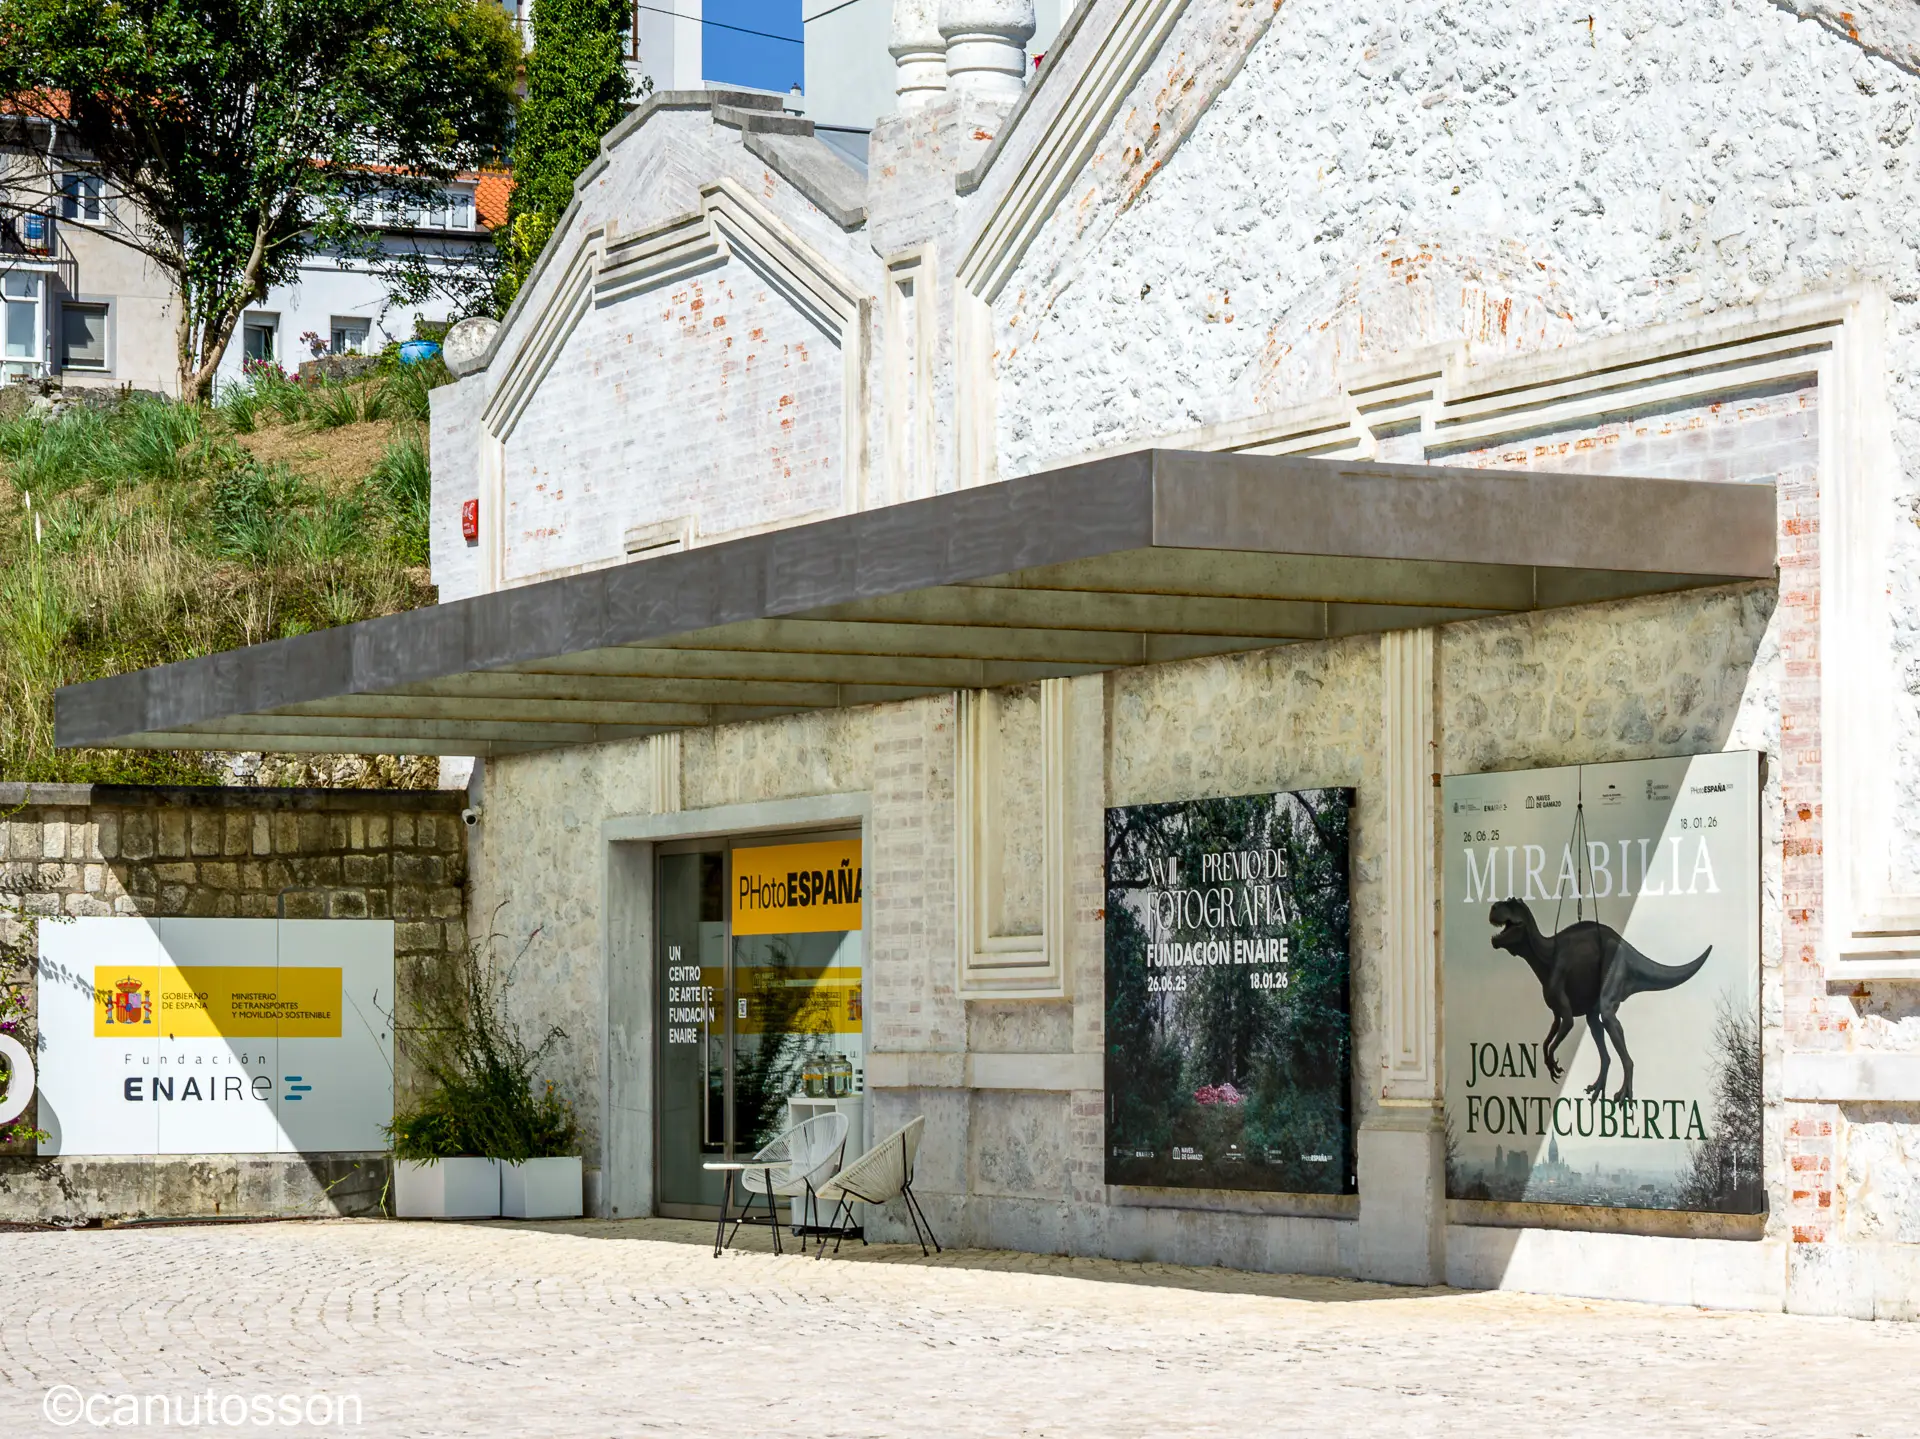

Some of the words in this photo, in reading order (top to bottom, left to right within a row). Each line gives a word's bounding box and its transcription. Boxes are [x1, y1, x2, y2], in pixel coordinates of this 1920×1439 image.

[1202, 850, 1261, 883] PREMIO
[1265, 848, 1287, 879] DE
[1463, 834, 1721, 903] MIRABILIA
[669, 946, 681, 960] UN
[1147, 935, 1230, 968] FUNDACIÓN
[1234, 938, 1288, 964] ENAIRE
[669, 966, 701, 981] CENTRO
[1147, 975, 1187, 992] 26.06.25
[1250, 972, 1288, 989] 18.01.26
[162, 992, 208, 1000] GOBIERNO
[669, 987, 680, 1002] DE
[681, 986, 700, 1002] ARTE
[285, 1011, 331, 1019] SOSTENIBLE
[669, 1028, 697, 1043] ENAIRE
[124, 1053, 266, 1065] Fundación
[1466, 1042, 1538, 1088] JOAN
[1466, 1095, 1709, 1141] FONTCUBERTA
